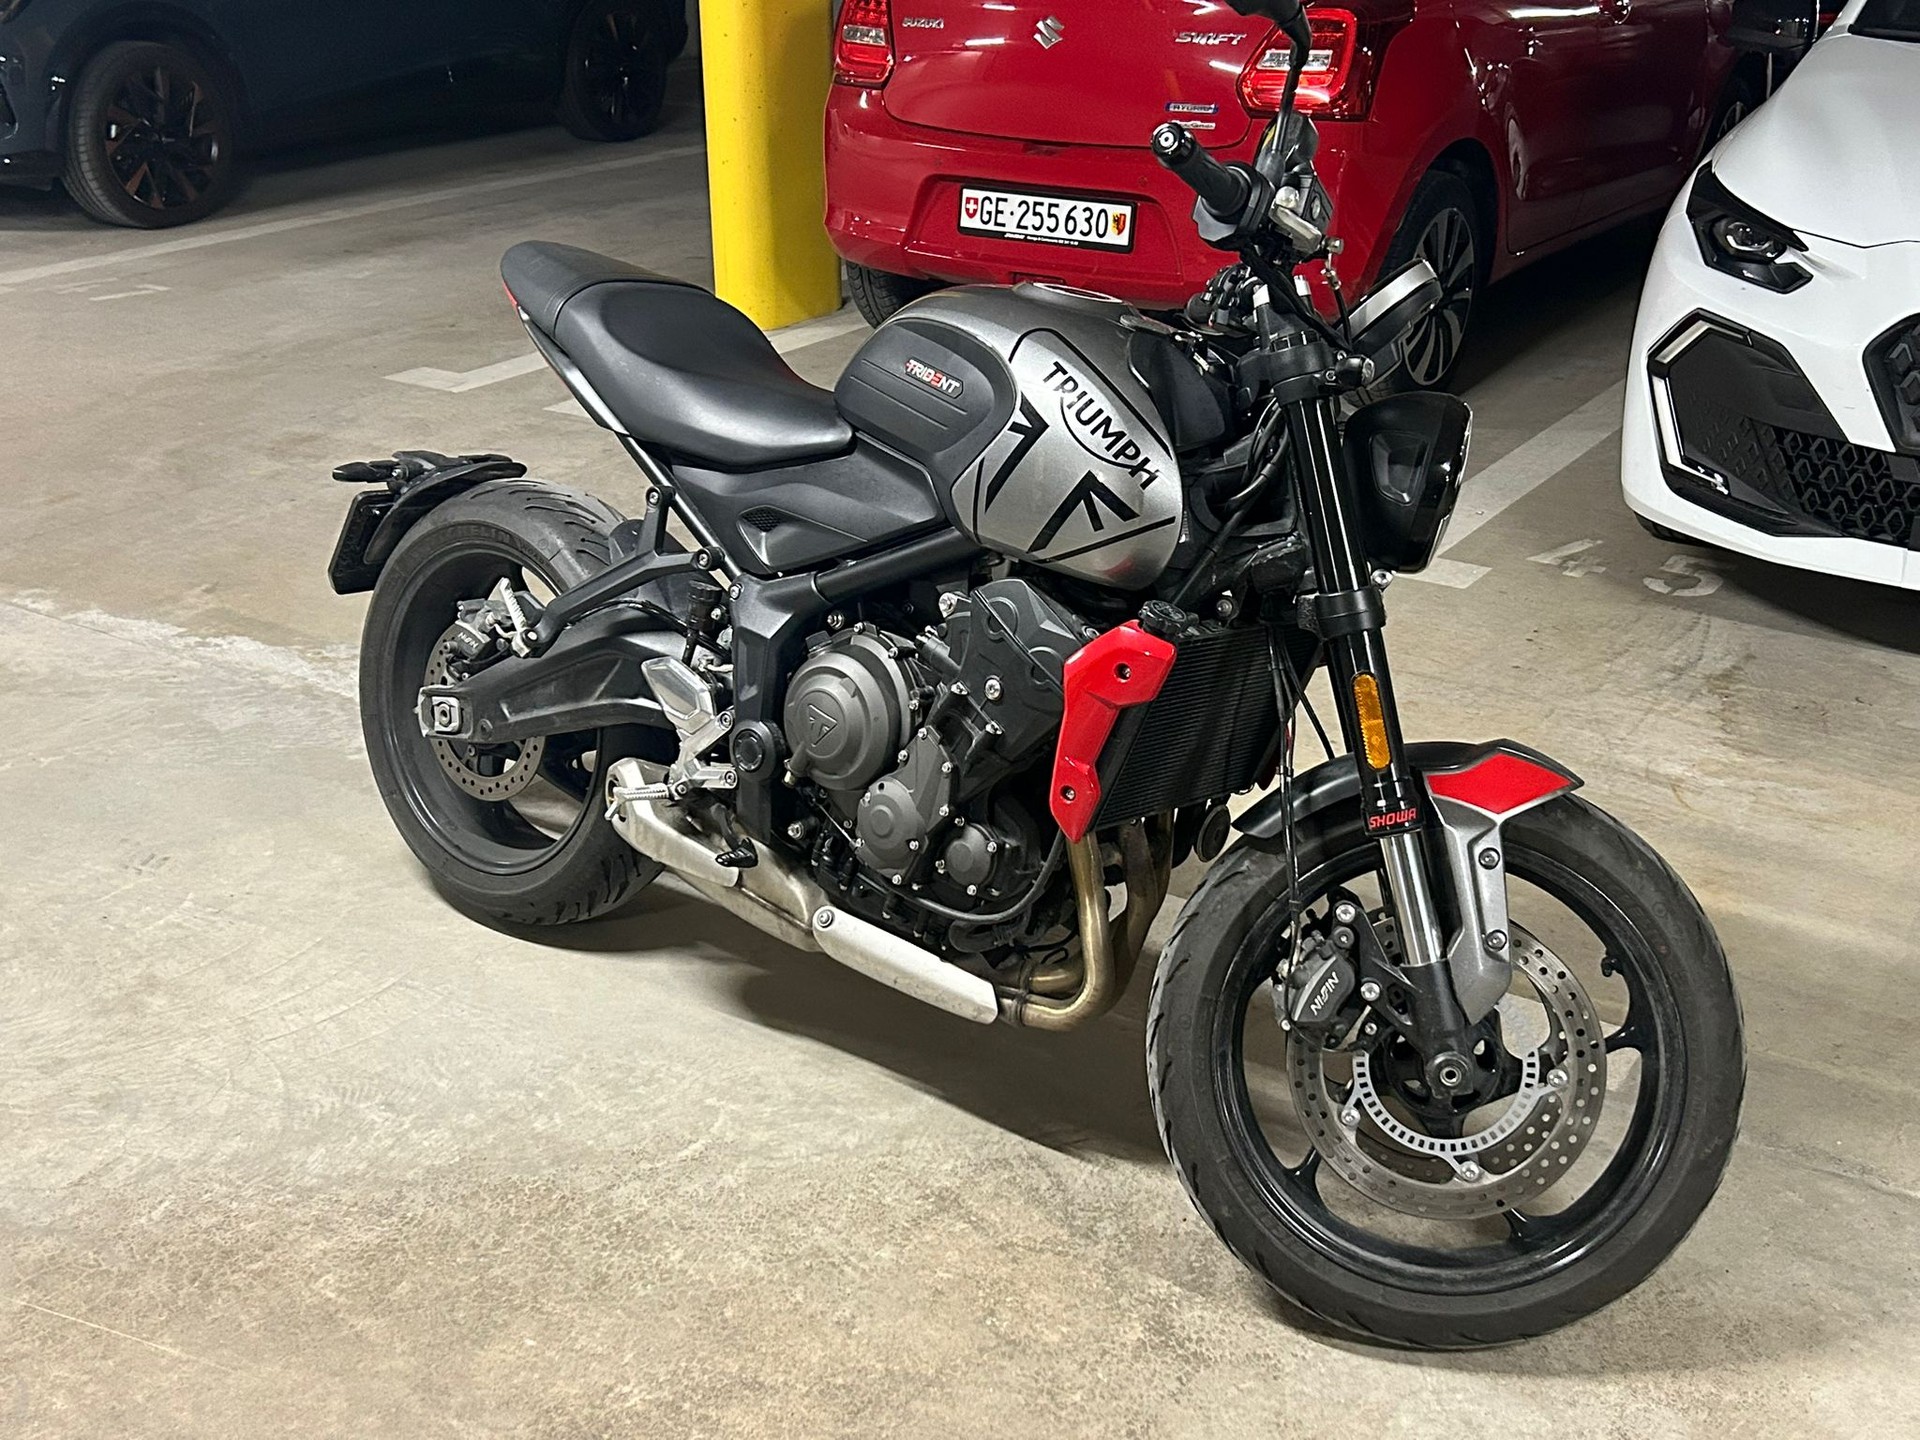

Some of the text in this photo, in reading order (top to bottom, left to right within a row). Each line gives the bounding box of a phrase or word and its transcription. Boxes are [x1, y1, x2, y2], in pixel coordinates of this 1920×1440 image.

[902, 18, 944, 29] SUZUKI
[1175, 32, 1247, 45] SWIFT
[906, 359, 960, 393] TRIDENT
[1043, 361, 1160, 490] TRIUMPH
[1369, 807, 1417, 829] SHOWA
